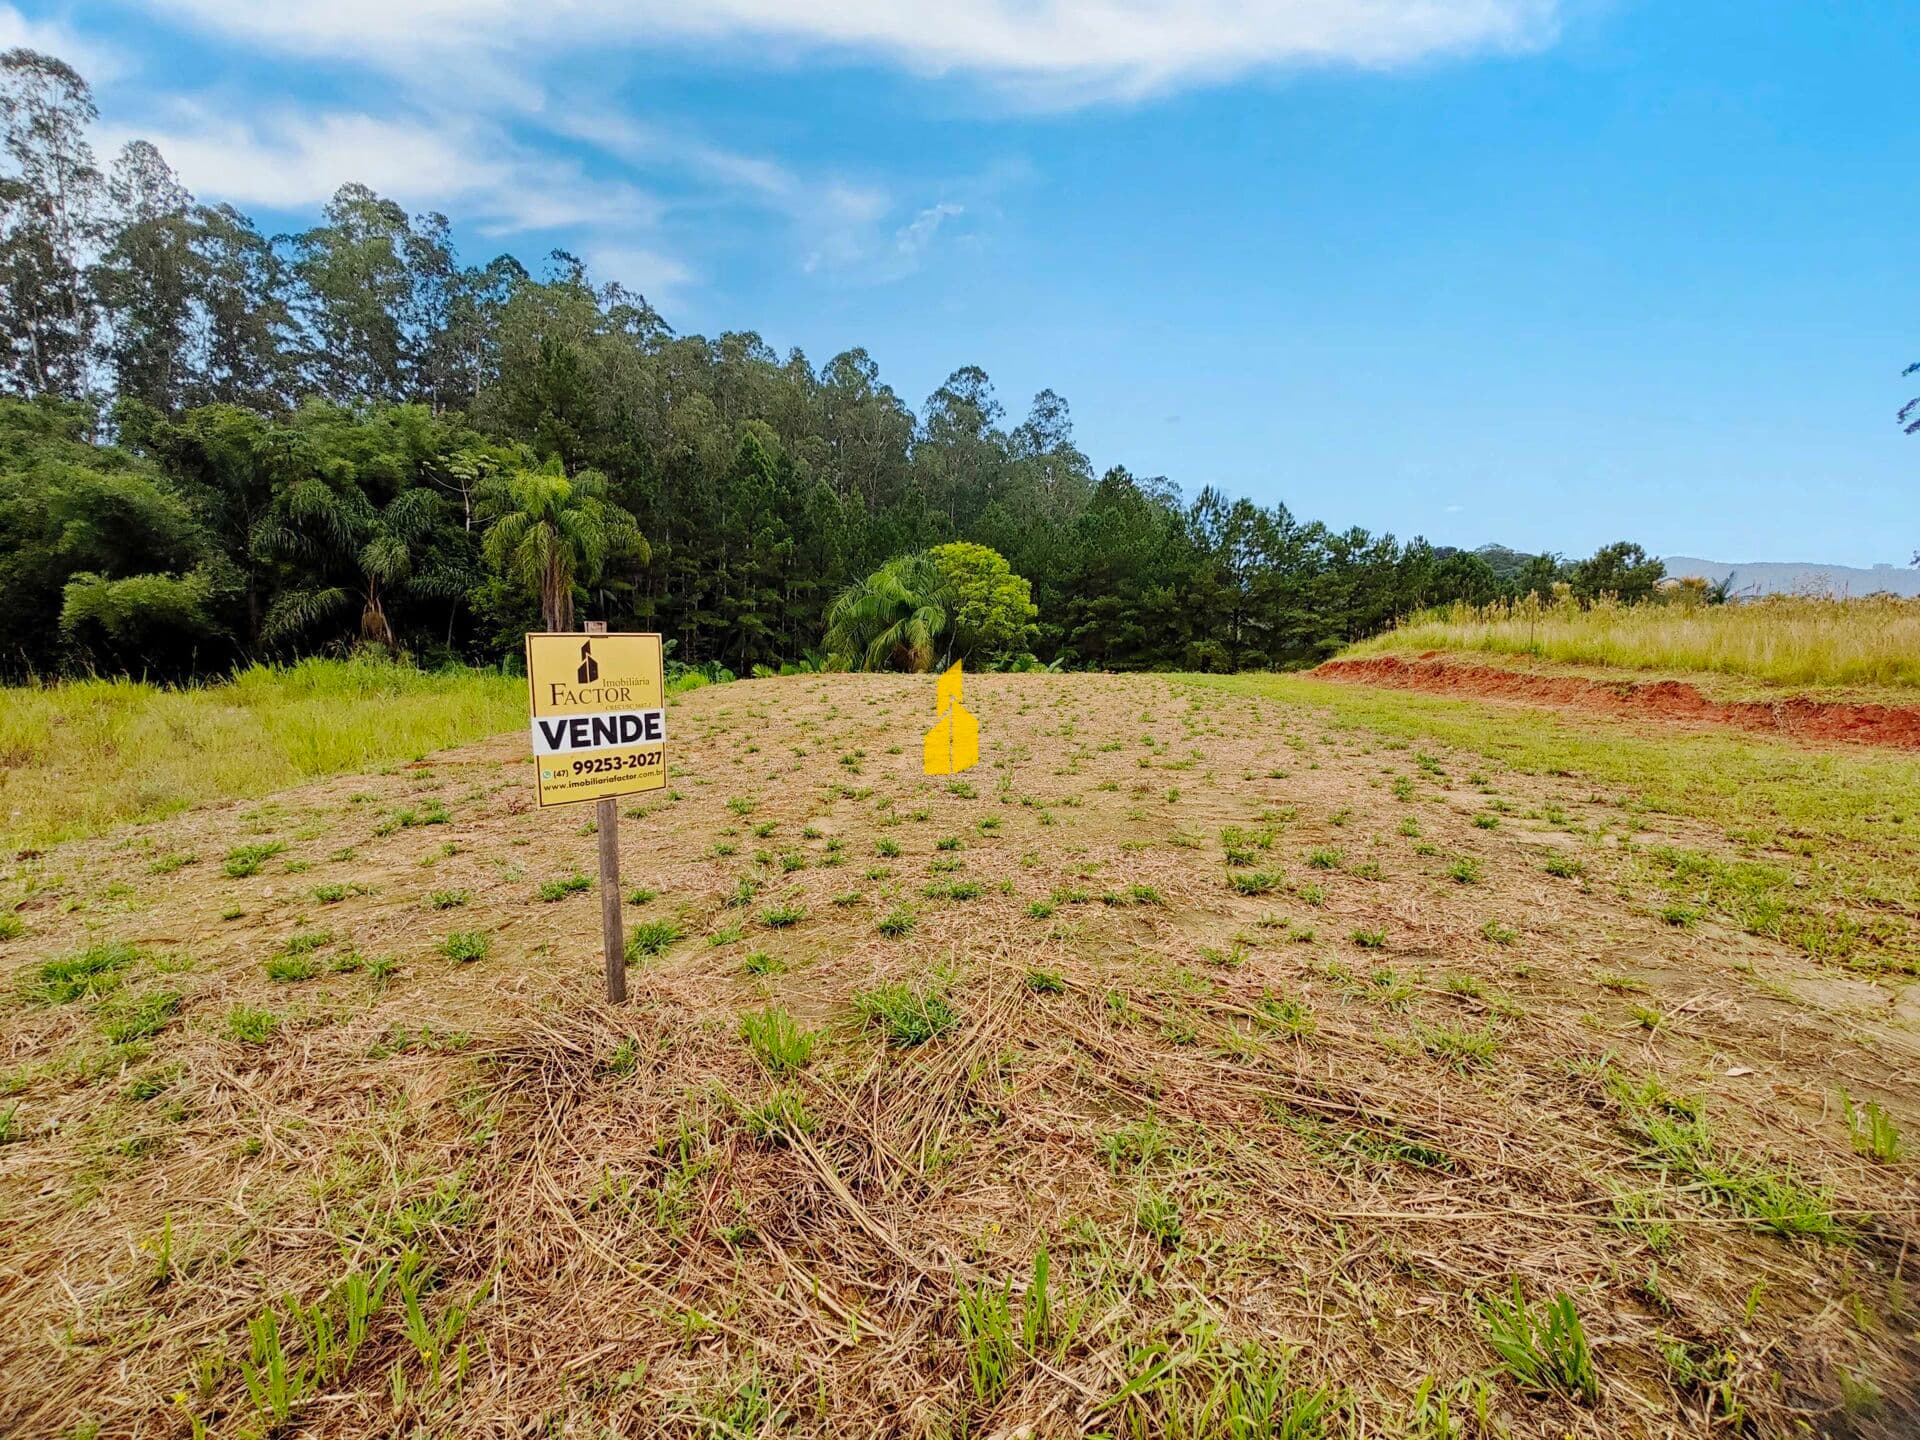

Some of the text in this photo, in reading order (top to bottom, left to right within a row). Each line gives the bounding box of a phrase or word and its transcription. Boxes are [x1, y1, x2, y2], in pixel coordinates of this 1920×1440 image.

[549, 683, 632, 706] FACTOR
[538, 712, 662, 750] VENDE
[553, 751, 662, 778] (47) 99253-2027
[543, 769, 664, 791] www.imobiliariafactor.com.br
